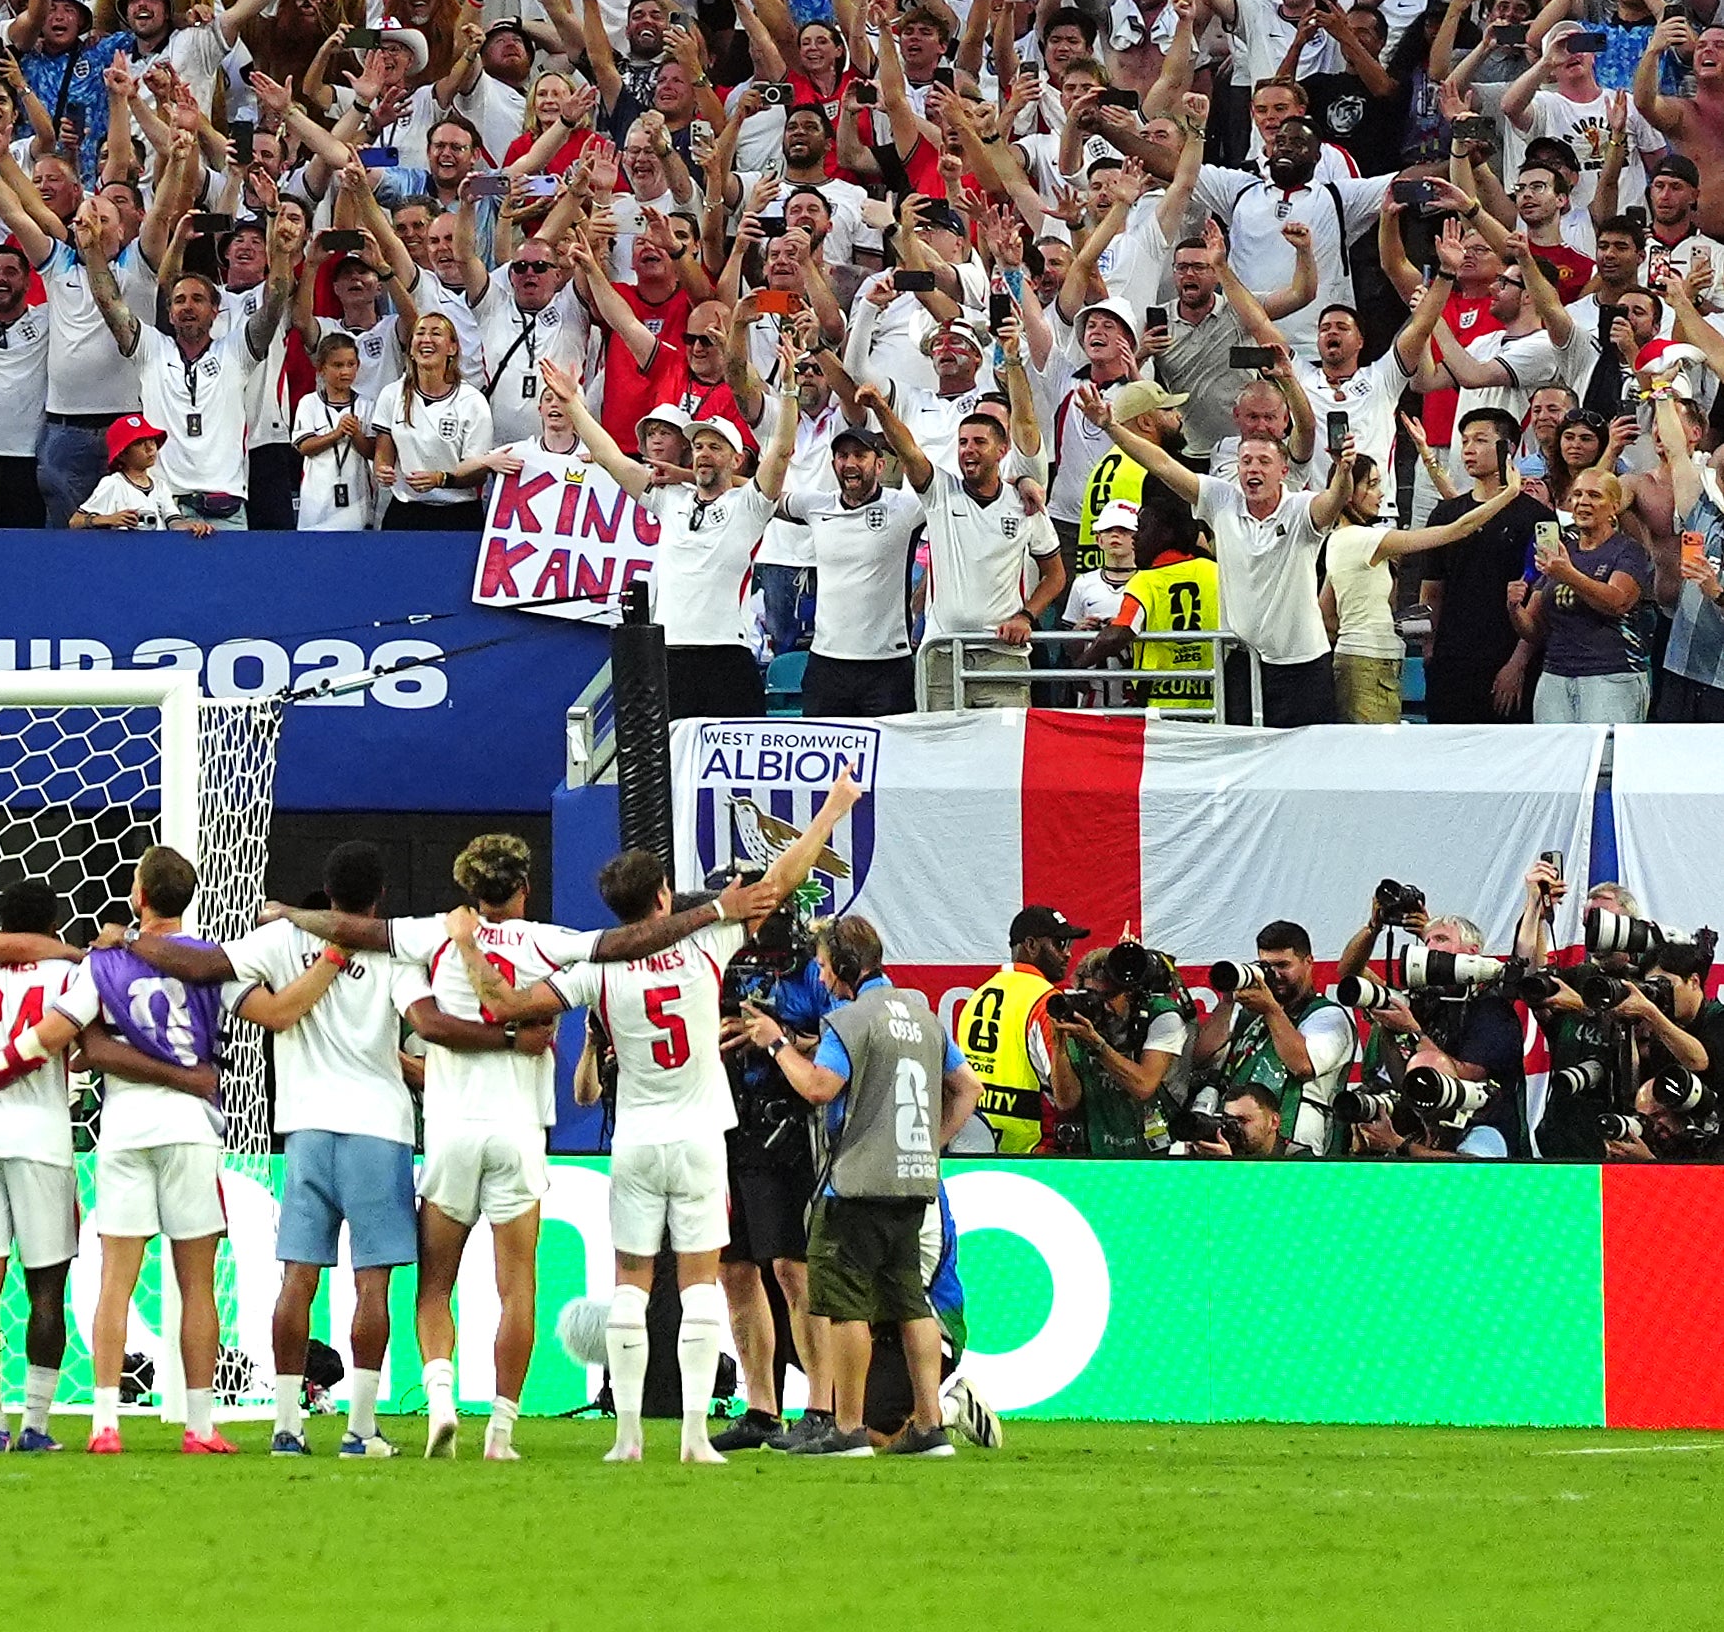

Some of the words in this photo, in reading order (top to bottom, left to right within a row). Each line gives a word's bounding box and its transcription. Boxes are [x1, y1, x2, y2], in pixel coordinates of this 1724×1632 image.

[703, 732, 754, 748] WEST
[761, 734, 867, 750] BROMWICH
[701, 749, 866, 783] ALBION
[644, 985, 690, 1069] 5
